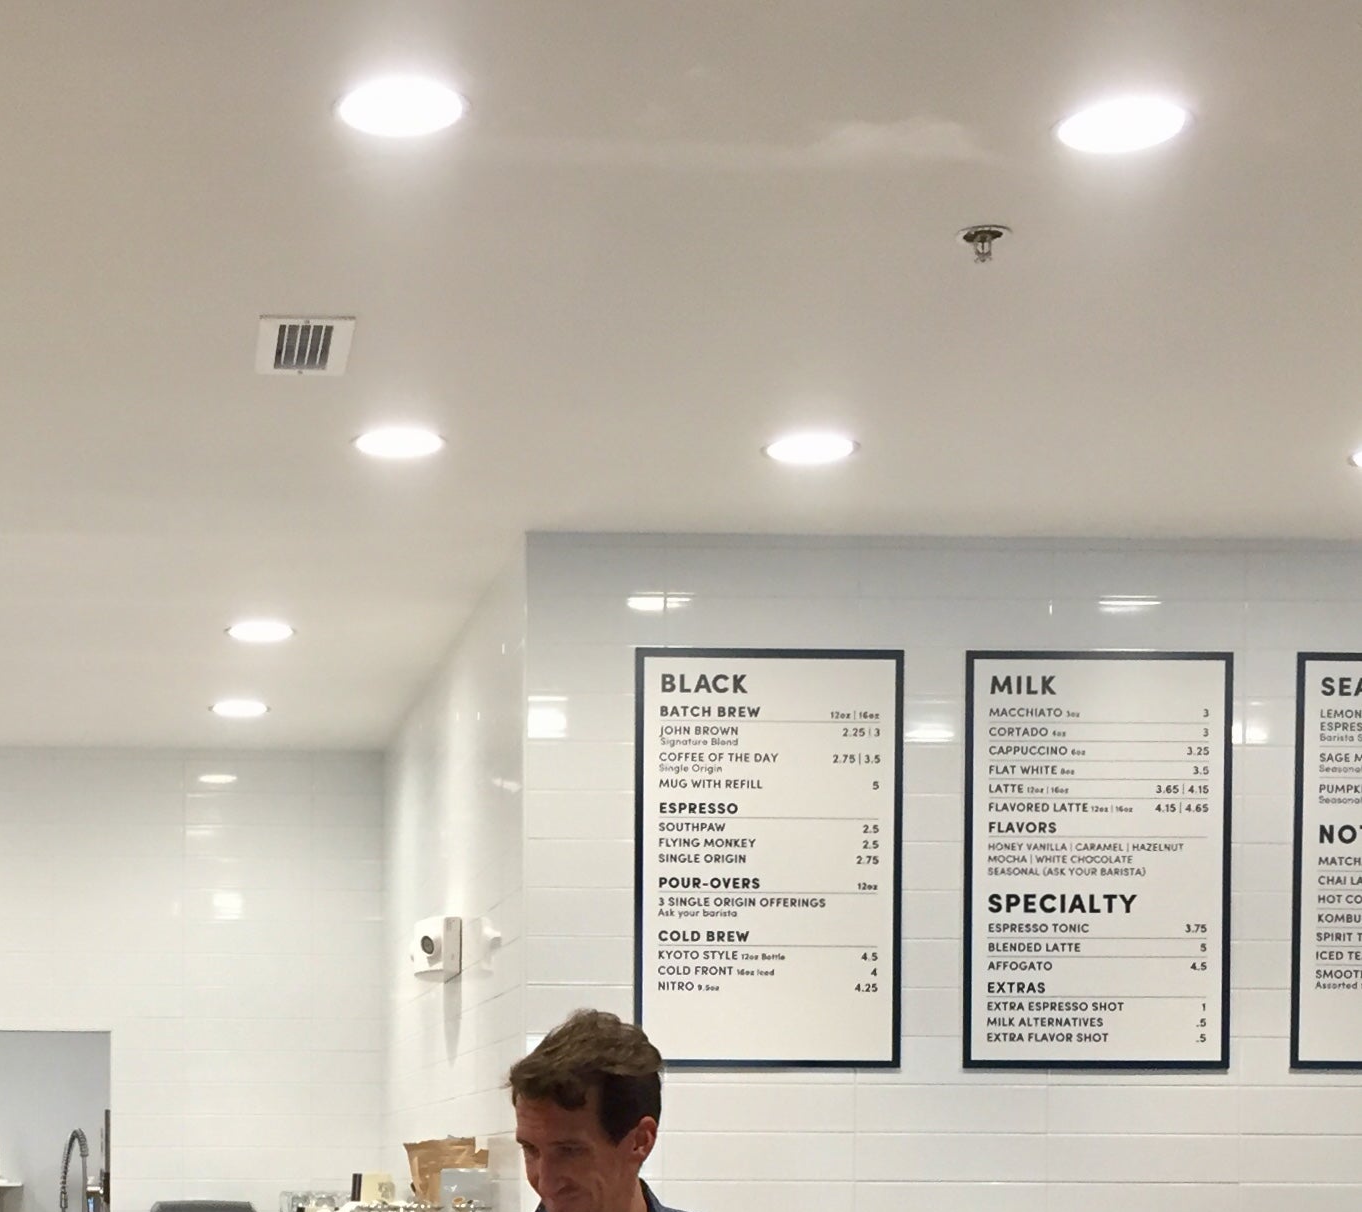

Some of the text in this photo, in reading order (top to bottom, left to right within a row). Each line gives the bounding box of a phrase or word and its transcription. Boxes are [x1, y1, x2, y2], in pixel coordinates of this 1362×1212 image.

[662, 674, 747, 693] BLACK
[990, 676, 1056, 695] MILK
[660, 706, 711, 717] BATCH
[718, 706, 760, 717] BREW
[989, 708, 1062, 717] MACCHIATO
[1203, 709, 1209, 717] 3
[659, 726, 880, 738] JOHN BROWN 2.25 3
[989, 727, 1048, 736] CORTADO
[1203, 728, 1209, 737] 3
[660, 738, 708, 747] Signature
[989, 746, 1067, 755] CAPPUCCINO
[1187, 747, 1209, 755] 3.25
[659, 752, 880, 764] COFFEE OF THE DAY 2.75 3.5
[1320, 753, 1350, 762] SAGE
[659, 763, 722, 775] Single Origin
[989, 765, 1016, 774] FLAT
[1020, 765, 1057, 774] WHITE
[1193, 766, 1209, 775] 3.5
[659, 779, 879, 790] MUG WITH REFILL 5
[989, 784, 1023, 793] LATTE
[1156, 785, 1179, 794] 3.65
[1188, 785, 1209, 794] 4.15
[660, 802, 738, 814] ESPRESSO
[989, 802, 1049, 812] FLAVORED
[1053, 803, 1088, 812] LATTE
[1155, 804, 1176, 812] 4.15
[1185, 804, 1208, 812] 4.65
[659, 822, 879, 833] SOUTHPAW 2.5
[989, 822, 1056, 833] FLAVORS
[659, 838, 879, 849] FLYING MONKEY 2.5
[988, 842, 1183, 851] HONEY VANILLA CARAMEL HAZELNUT
[659, 854, 879, 865] SINGLE ORIGIN 2.75
[988, 855, 1133, 864] MOCHA WHITE CHOCOLATE
[988, 867, 1146, 876] SEASONAL (ASK YOUR BARISTA)
[659, 877, 760, 889] POUR-OVERS
[1318, 876, 1346, 885] CHAI
[659, 897, 826, 908] 3 SINGLE ORIGIN OFFERINGS
[988, 894, 1137, 913] SPECIALTY
[1318, 895, 1342, 904] HOT
[703, 909, 737, 917] barista
[988, 923, 1207, 933] ESPRESSO TONIC 3.75
[658, 930, 749, 942] COLD BREW
[1316, 932, 1353, 941] SPIRIT
[988, 943, 1206, 952] BLENDED LATTE 5
[658, 950, 699, 960] KYOTO
[703, 951, 738, 960] STYLE
[862, 952, 878, 961] 4.5
[1316, 951, 1343, 960] ICED
[658, 966, 691, 975] COLD
[695, 966, 733, 975] FRONT
[871, 968, 877, 976] 4
[988, 961, 1207, 971] AFFOGATO 4.5
[658, 981, 694, 991] NITRO
[855, 983, 878, 992] 4.25
[988, 982, 1045, 993] EXTRAS
[1315, 981, 1358, 989] Assorted
[987, 1002, 1024, 1011] EXTRA
[1028, 1002, 1088, 1011] ESPRESSO
[1092, 1002, 1124, 1011] SHOT
[987, 1017, 1206, 1027] MILK ALTERNATIVES .5
[987, 1033, 1206, 1042] EXTRA FLAVOR SHOT .5
